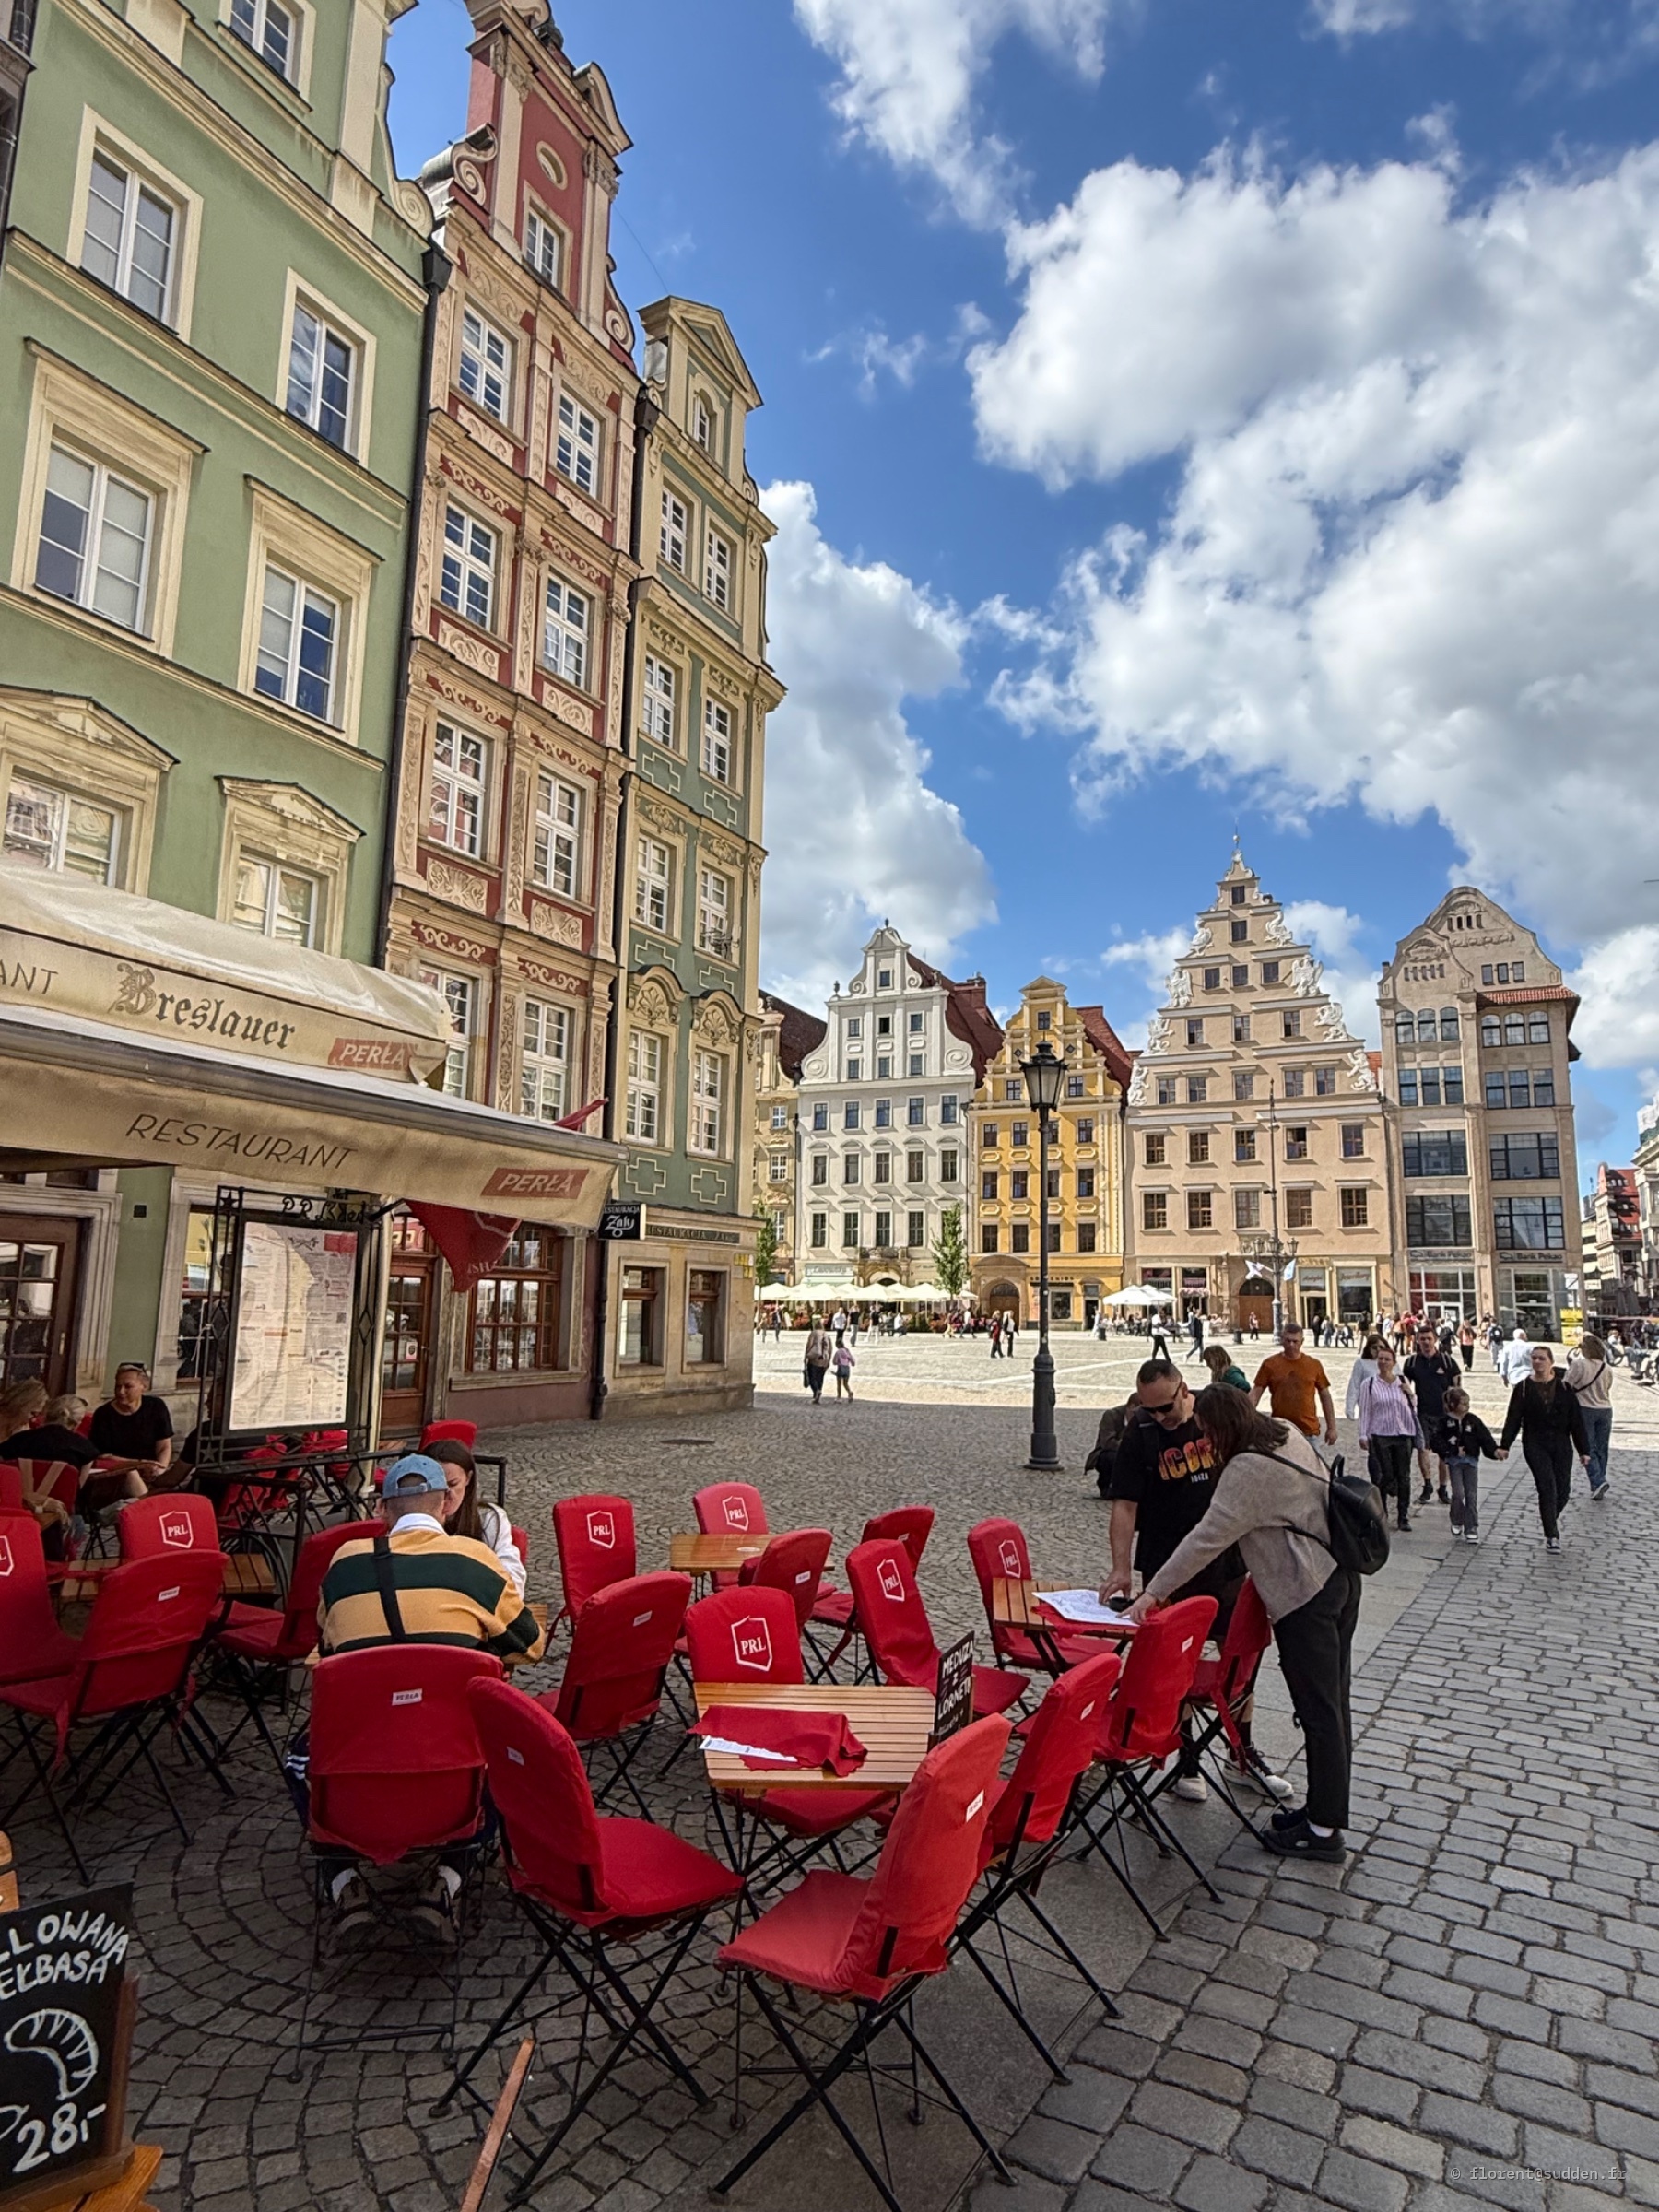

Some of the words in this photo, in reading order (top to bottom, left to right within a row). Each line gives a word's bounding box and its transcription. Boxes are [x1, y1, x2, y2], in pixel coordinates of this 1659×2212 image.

[107, 962, 296, 1050] Breslauer
[339, 1043, 405, 1067] PERŁA
[125, 1113, 358, 1169] RESTAURANT
[498, 1173, 575, 1192] PERŁA
[728, 1508, 745, 1521] PRL
[167, 1524, 189, 1537] PRL
[593, 1524, 611, 1536] PRL
[884, 1574, 900, 1591] PRL
[740, 1636, 767, 1655] PRL
